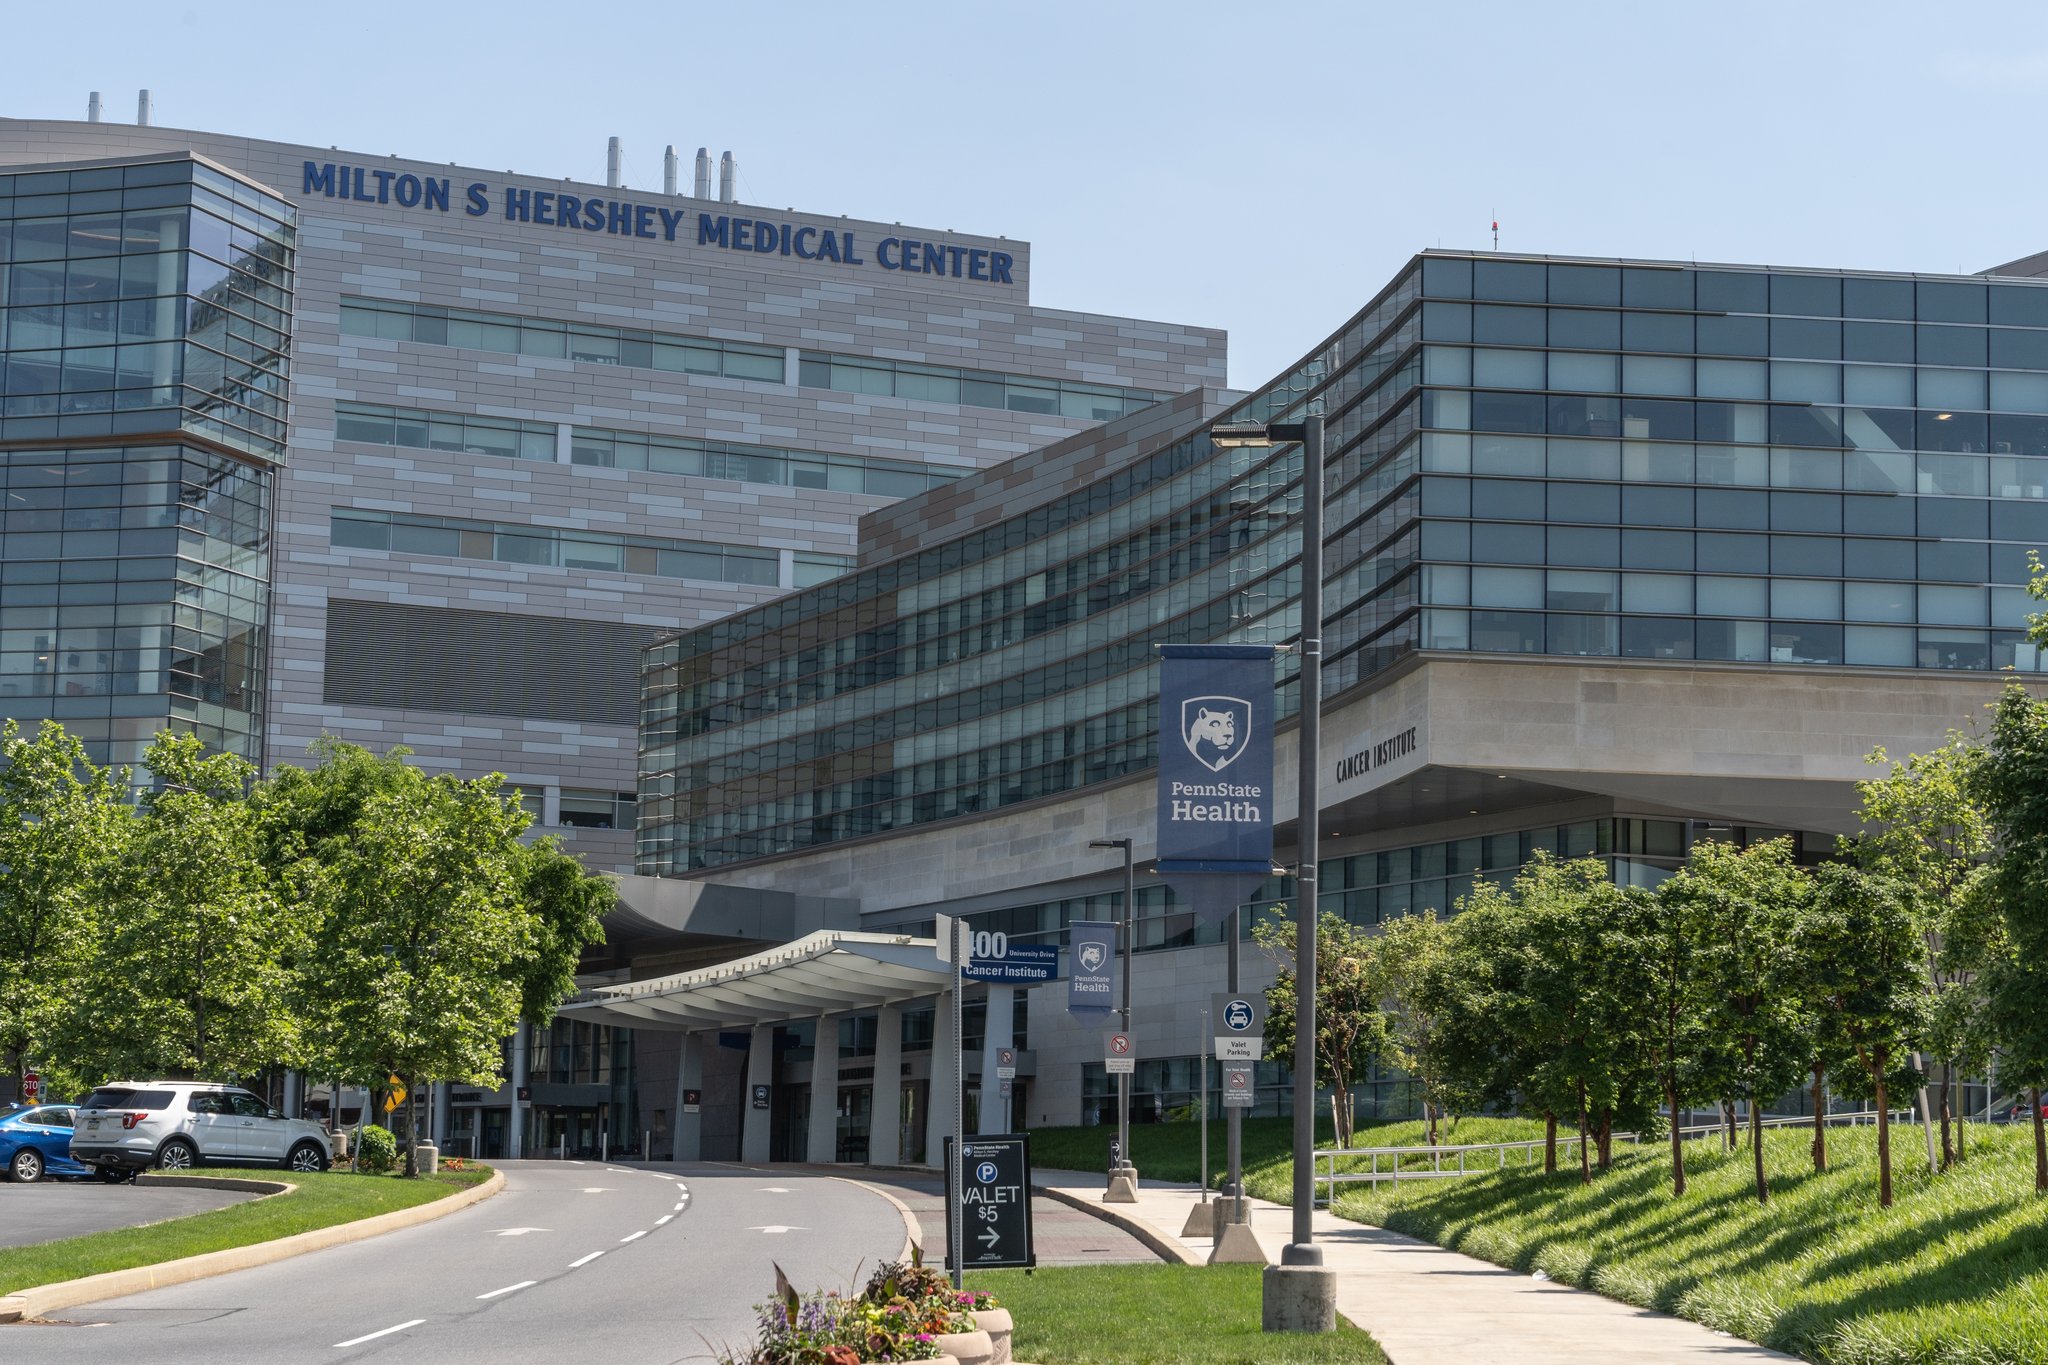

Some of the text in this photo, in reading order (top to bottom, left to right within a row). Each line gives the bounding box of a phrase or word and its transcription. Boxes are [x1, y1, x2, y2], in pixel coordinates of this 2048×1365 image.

[303, 161, 1013, 284] MILTON S HERSHEY MEDICAL CENTER
[1336, 726, 1416, 784] CANCER INSTITUTE
[1171, 781, 1261, 798] PennState
[1171, 800, 1261, 823] Health
[1009, 949, 1038, 958] University
[1039, 950, 1055, 958] Drive
[966, 964, 1047, 978] Cancer Institute
[1074, 975, 1110, 983] PennState
[1074, 982, 1110, 993] Health
[23, 1081, 38, 1090] STO
[982, 1166, 994, 1180] P
[961, 1186, 1020, 1205] VALET
[978, 1206, 998, 1222] $5
